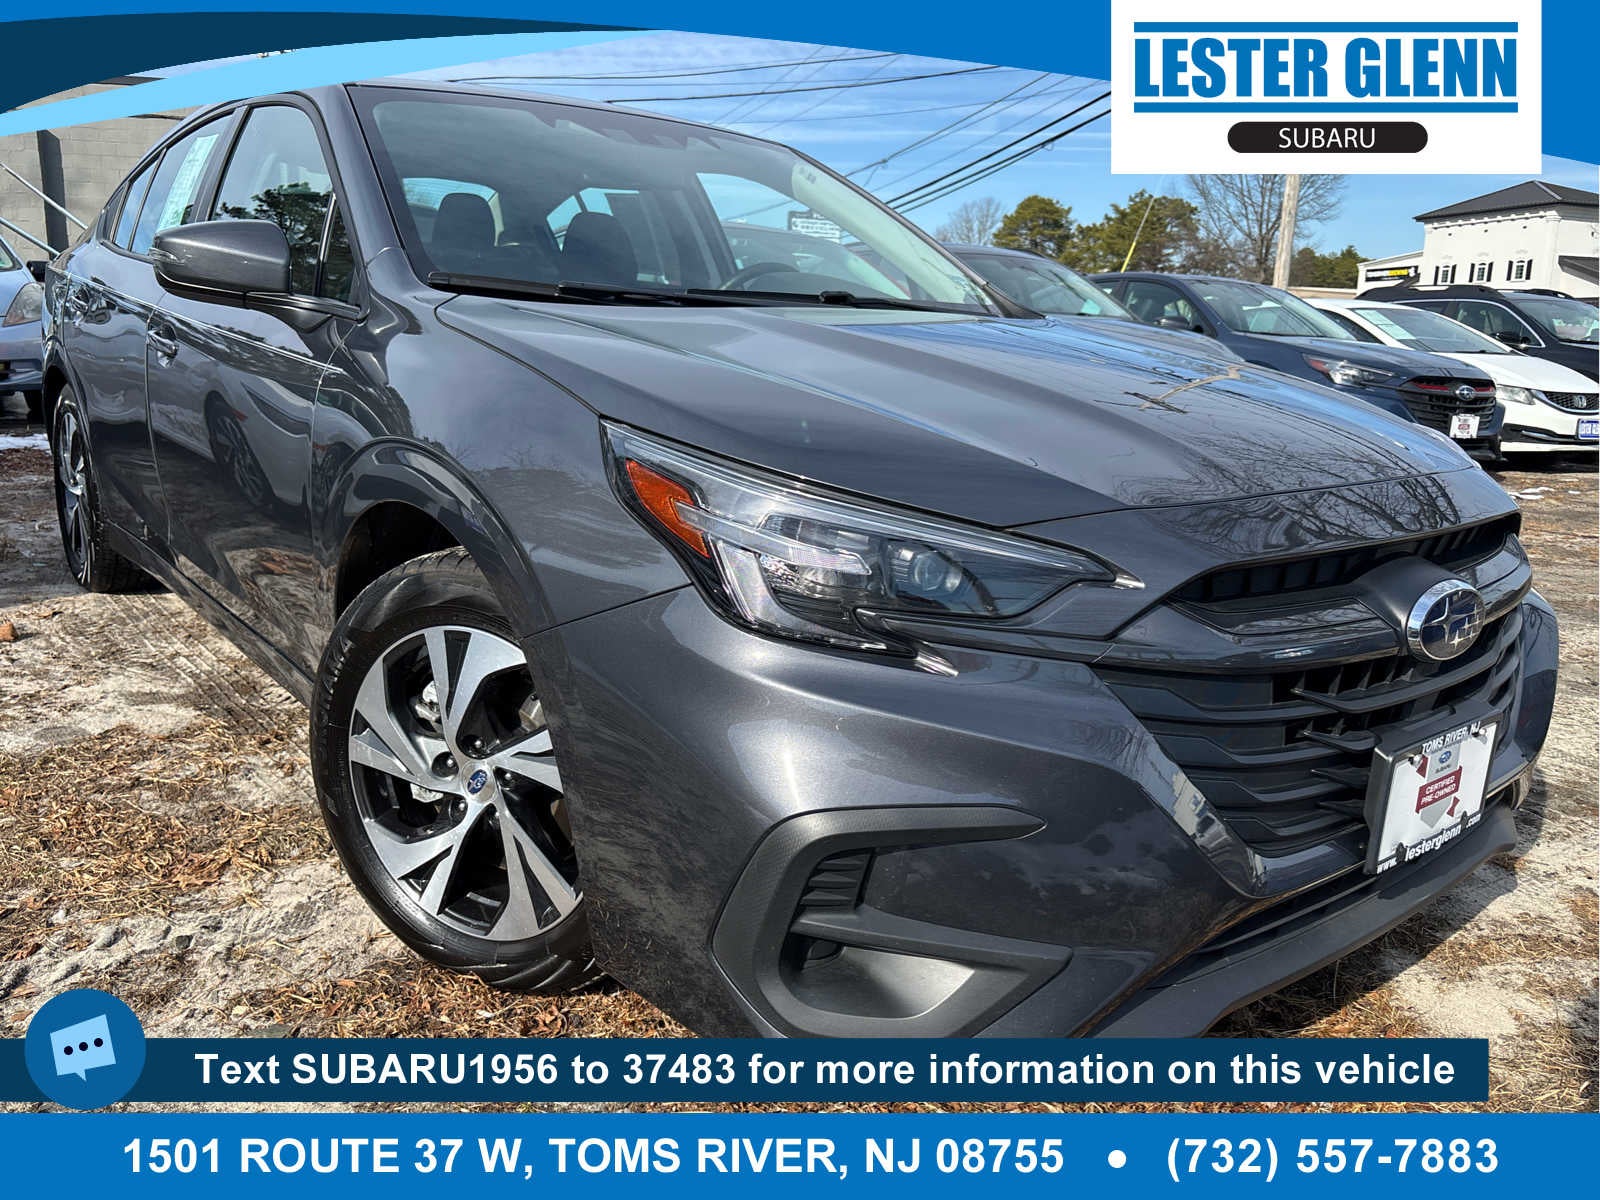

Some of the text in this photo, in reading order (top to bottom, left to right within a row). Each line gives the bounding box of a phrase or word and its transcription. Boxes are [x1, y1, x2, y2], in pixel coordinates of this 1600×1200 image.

[1422, 735, 1444, 755] TOMS
[1470, 720, 1481, 736] NJ
[1420, 783, 1456, 805] PRE-OWNED
[1425, 775, 1456, 795] CERTIFIED
[1405, 825, 1462, 862] lesterglenn
